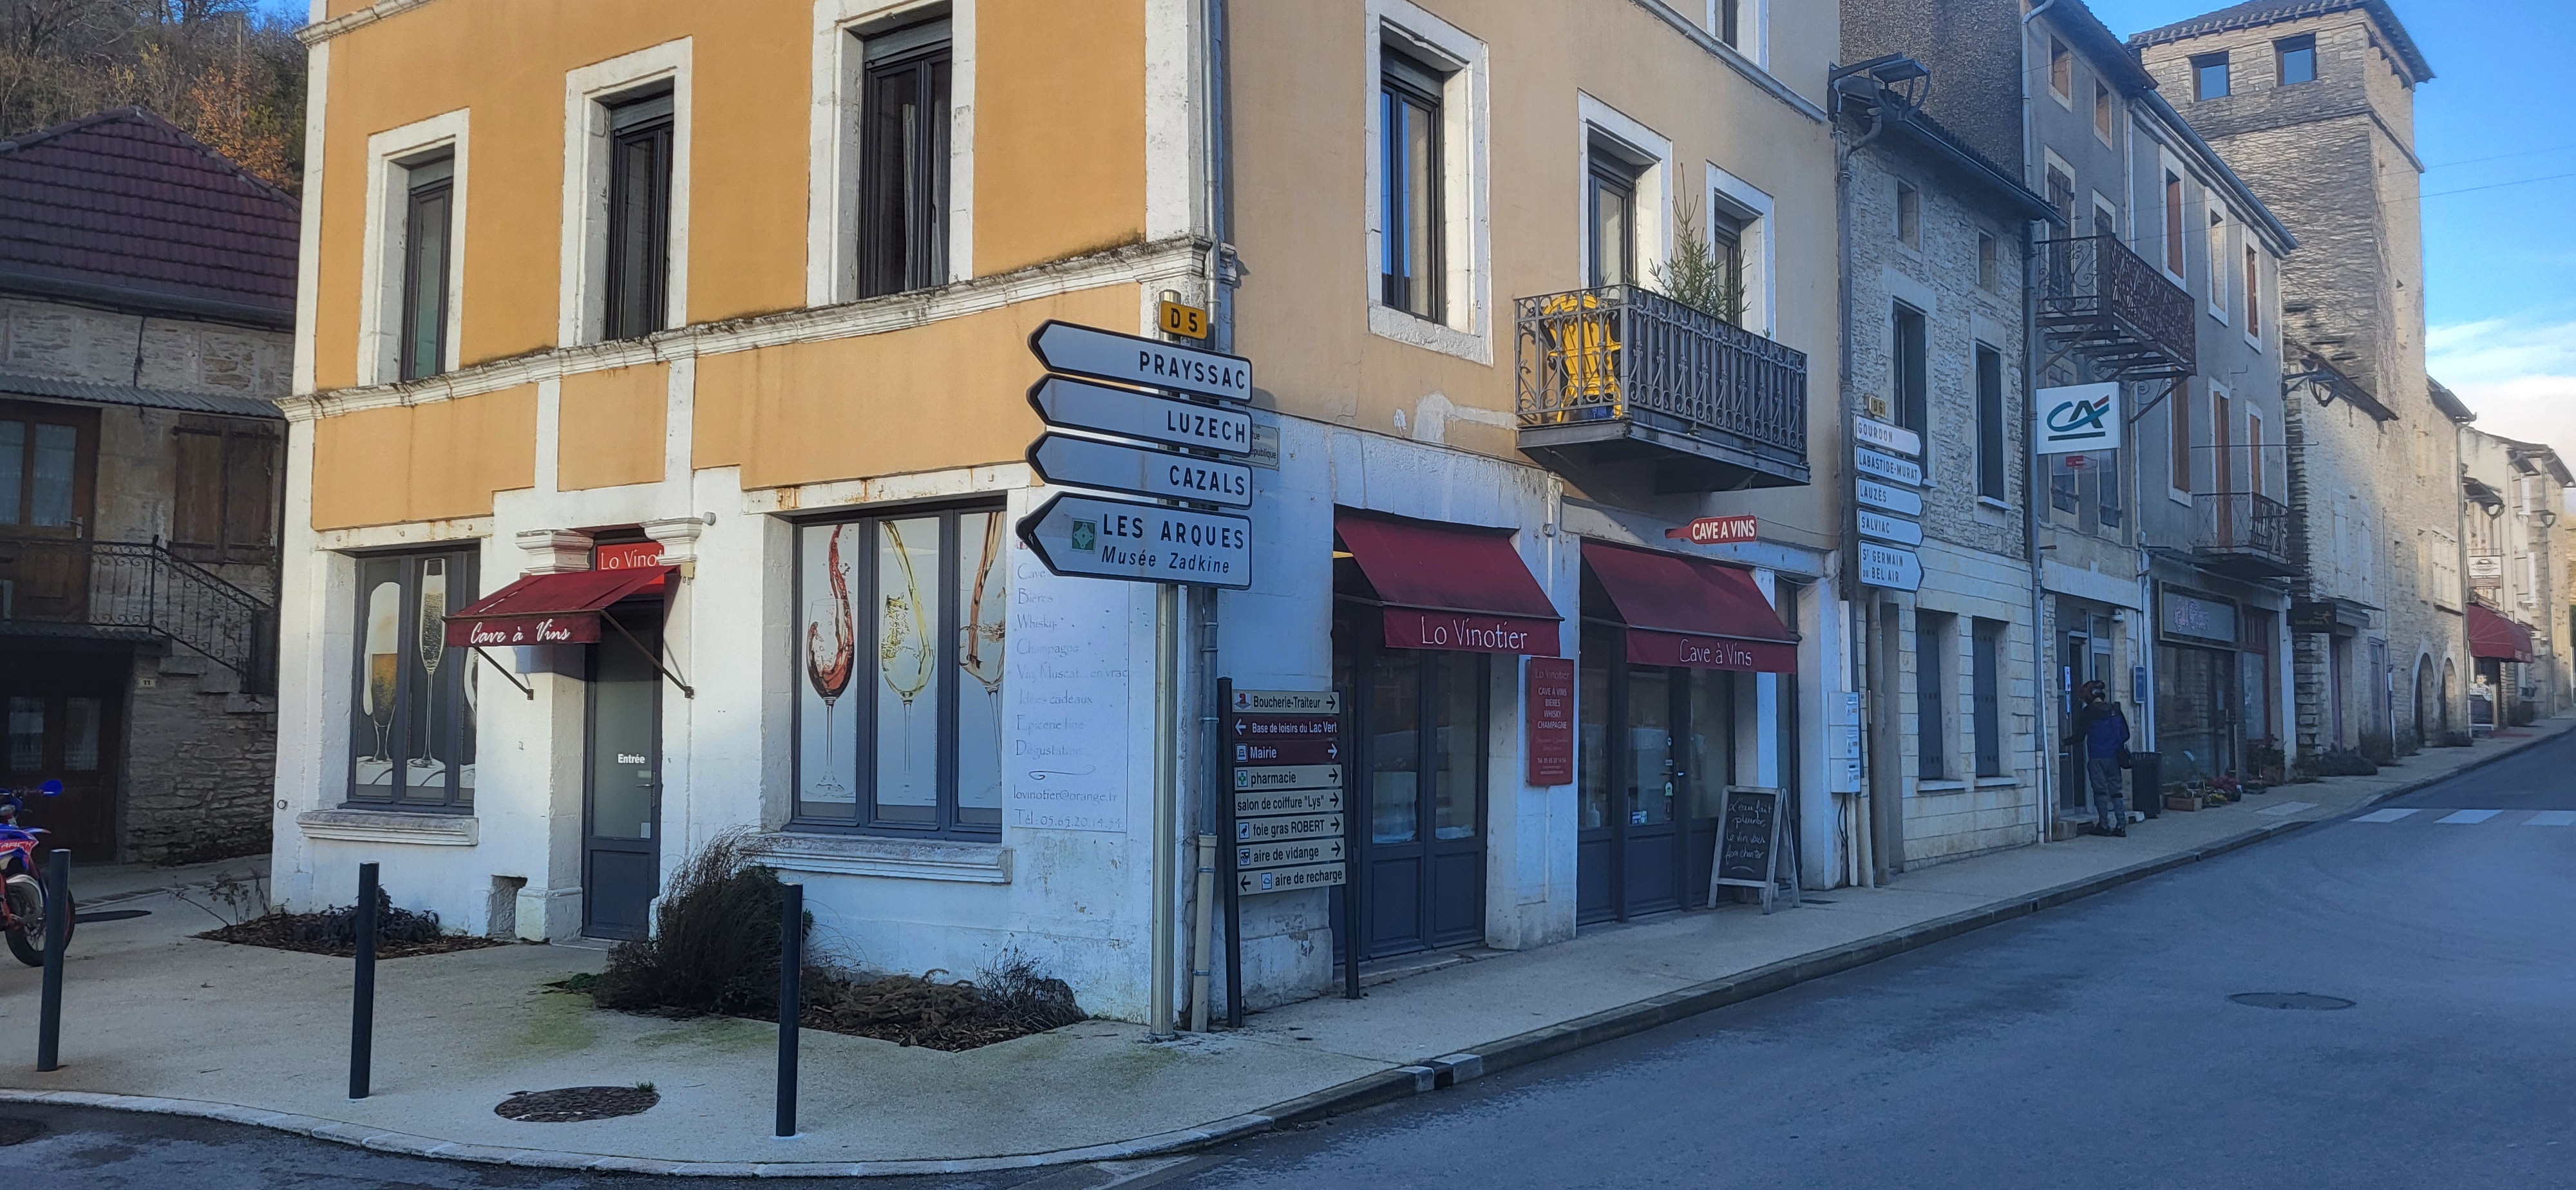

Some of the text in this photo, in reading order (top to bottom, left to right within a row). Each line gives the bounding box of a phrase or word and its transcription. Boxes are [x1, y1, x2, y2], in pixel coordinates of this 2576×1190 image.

[1170, 307, 1198, 333] D 5
[1139, 350, 1245, 390] PRAYSSAC
[1873, 399, 1883, 414] D 6
[1168, 410, 1245, 444] LUZECH
[1858, 421, 1893, 444] GOURDON
[1859, 453, 1918, 481] LABASTIDE-MURAT
[1170, 465, 1245, 496] CAZALS
[1860, 484, 1887, 503] LAUZÈS
[1103, 513, 1244, 549] LES ARQUES
[1692, 519, 1755, 540] CAVE A VINS
[1861, 516, 1890, 534] SALVIAC
[601, 552, 618, 570] Lo
[1101, 545, 1229, 574] Musée Zadkine
[1872, 550, 1903, 567] GERMAIN
[1017, 563, 1046, 580] Cave
[1862, 567, 1899, 583] DU BEL AIR
[470, 618, 571, 644] Cave à Vins
[1017, 614, 1056, 631] Whisky
[1421, 615, 1527, 649] Lo Vinotier
[1016, 638, 1079, 657] Champagne
[1680, 639, 1752, 666] Cave à Vins
[1535, 668, 1570, 679] Lo Vinotier
[1050, 690, 1093, 704] cadeaux
[1538, 686, 1551, 695] CAVE
[1557, 688, 1567, 696] VINS
[1253, 695, 1320, 709] Boucherie-Traiteur
[1065, 715, 1084, 730] fine
[1544, 710, 1562, 718] WHISKY
[1252, 721, 1338, 733] Base de loisirs du Lac Vert
[1537, 721, 1567, 729] CHAMPAGNE
[618, 753, 645, 764] Entrée
[1250, 746, 1277, 759] Mairie
[1251, 771, 1296, 788] pharmacie
[1014, 784, 1117, 806] lovinotier@orange.fr
[1237, 795, 1324, 811] salon de coiffure "Lys"
[1755, 799, 1772, 819] fait
[1253, 819, 1325, 838] foie gras ROBERT
[1736, 831, 1748, 843] vin
[1253, 845, 1319, 863] aire de vidange
[1739, 845, 1765, 859] chanter
[1275, 869, 1343, 887] aire de recharge
